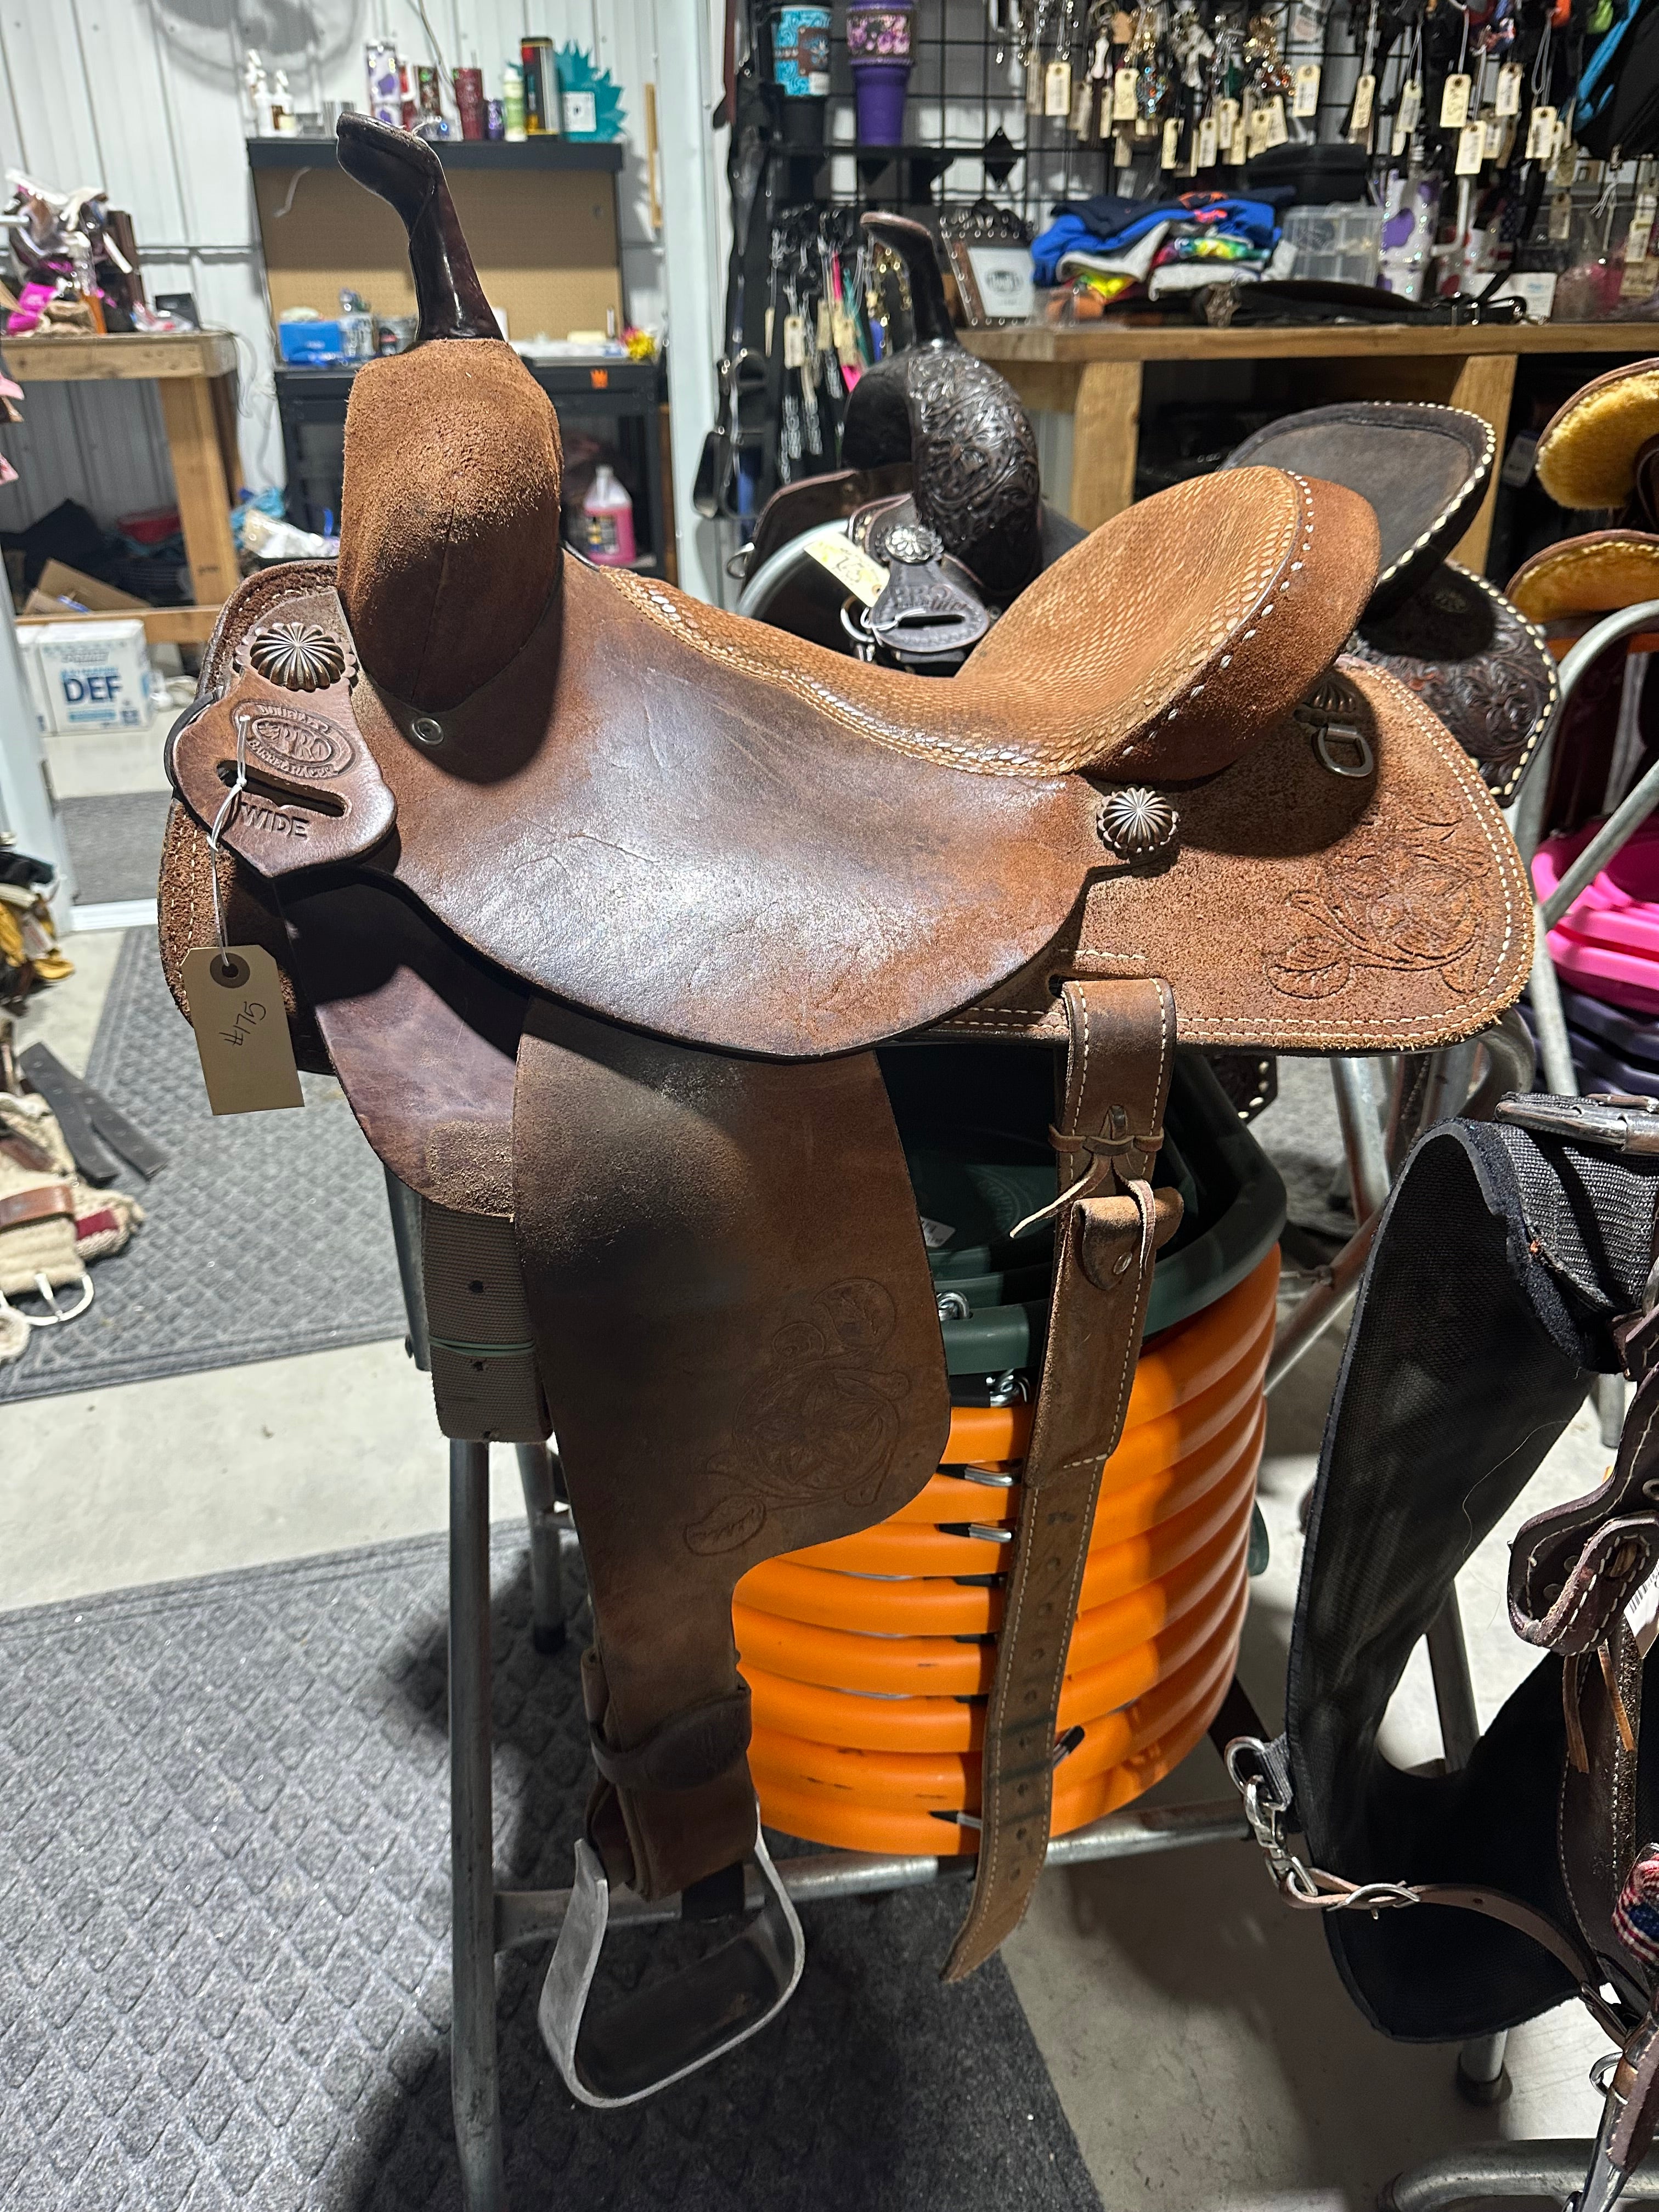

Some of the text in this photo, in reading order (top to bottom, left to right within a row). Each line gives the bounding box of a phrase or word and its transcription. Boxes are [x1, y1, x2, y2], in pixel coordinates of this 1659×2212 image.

[63, 675, 122, 704] DEF
[255, 703, 316, 729] DOUBLE
[247, 739, 338, 778] BARREL RACER
[276, 723, 332, 761] PRO
[240, 802, 309, 840] WIDE
[219, 1001, 266, 1046] #175
